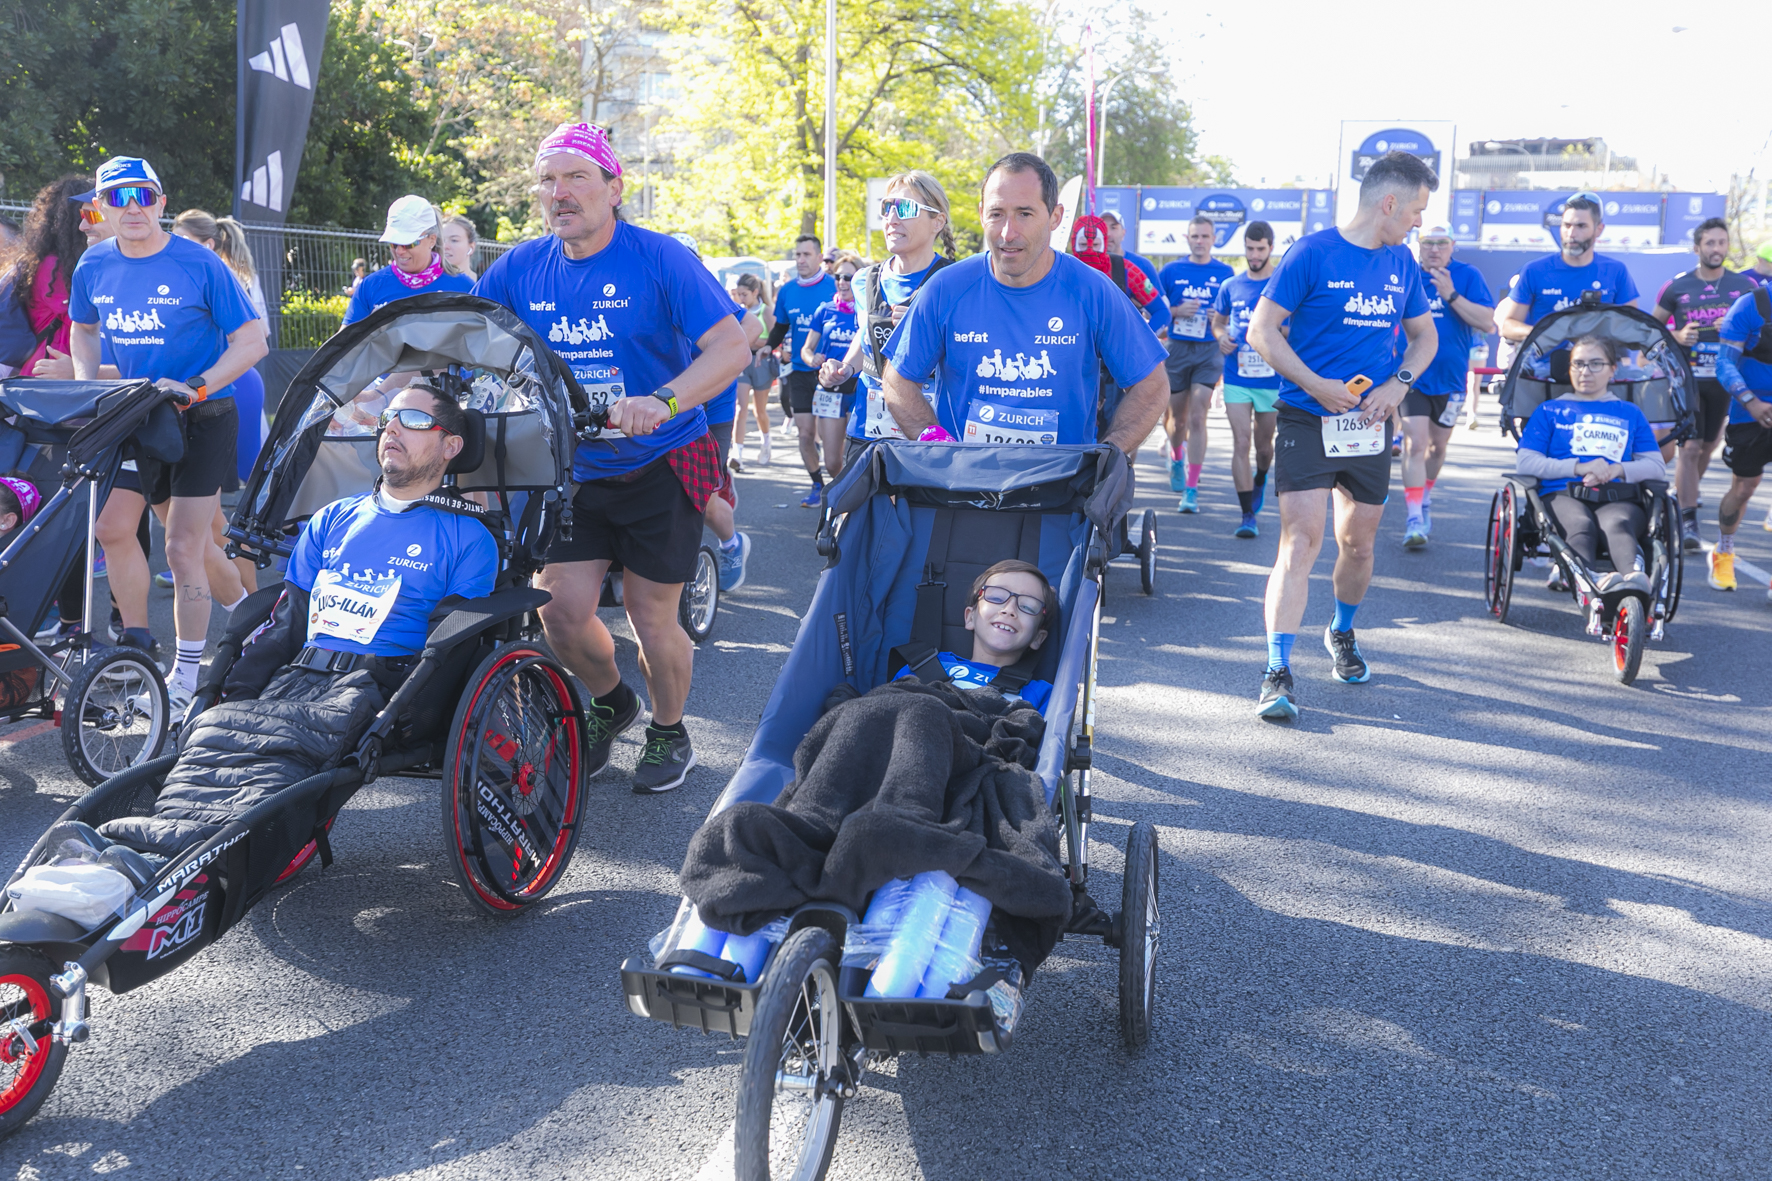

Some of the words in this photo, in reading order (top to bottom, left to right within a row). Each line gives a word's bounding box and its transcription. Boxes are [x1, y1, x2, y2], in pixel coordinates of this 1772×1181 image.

[1327, 280, 1355, 288] aefat
[147, 297, 180, 306] ZURICH
[529, 301, 556, 311] aefat
[592, 300, 628, 310] ZURICH
[954, 331, 989, 343] aefat
[1034, 336, 1076, 345] ZURICH
[574, 369, 611, 379] ZURICH
[979, 385, 1053, 398] #Imparables
[998, 412, 1044, 426] ZURICH
[1583, 430, 1619, 442] CARMEN
[387, 556, 428, 572] ZURICH
[344, 580, 389, 594] ZURICH
